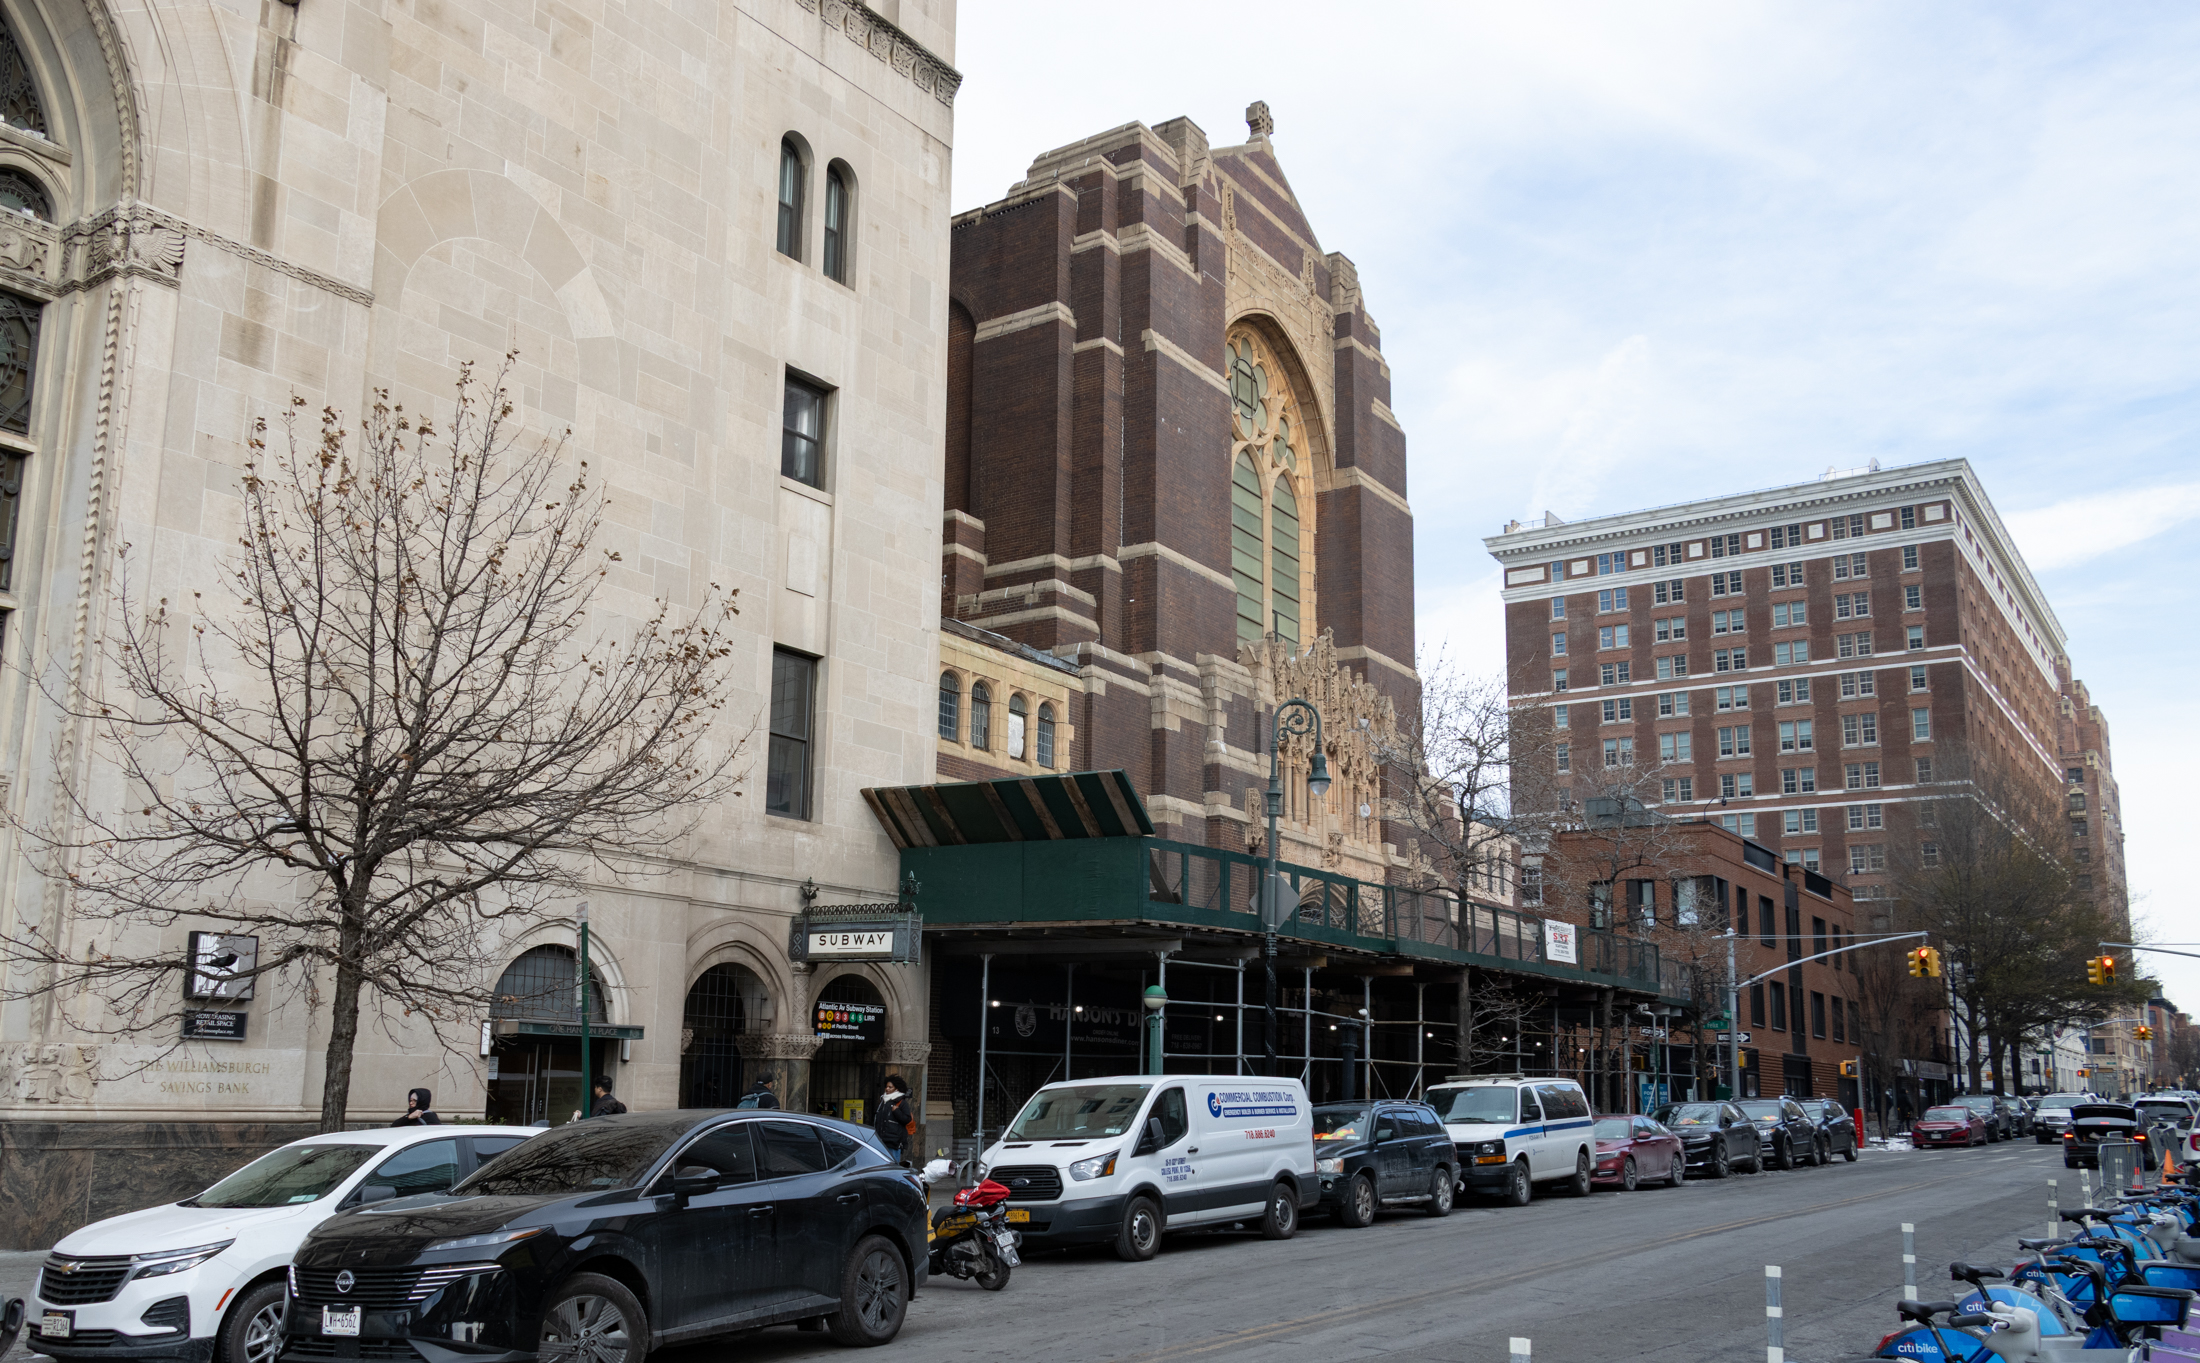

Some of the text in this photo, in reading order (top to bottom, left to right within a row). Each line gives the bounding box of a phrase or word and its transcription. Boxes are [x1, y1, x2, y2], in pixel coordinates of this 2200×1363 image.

[818, 933, 886, 946] SUBWAY
[818, 1002, 884, 1014] Atlantic Av Subway Station
[549, 1024, 618, 1036] ONE HANON PLACE
[992, 1027, 1000, 1035] 13
[166, 1060, 270, 1074] WILLIAMSBURGH
[160, 1082, 250, 1094] SAVINGS BANK
[1219, 1091, 1296, 1104] COMMERCIAL COMBUSTION Corp.
[1244, 1129, 1276, 1140] 718.886.6240
[2026, 1269, 2039, 1278] citi
[1966, 1301, 1983, 1312] citi
[1897, 1342, 1938, 1353] citi bike
